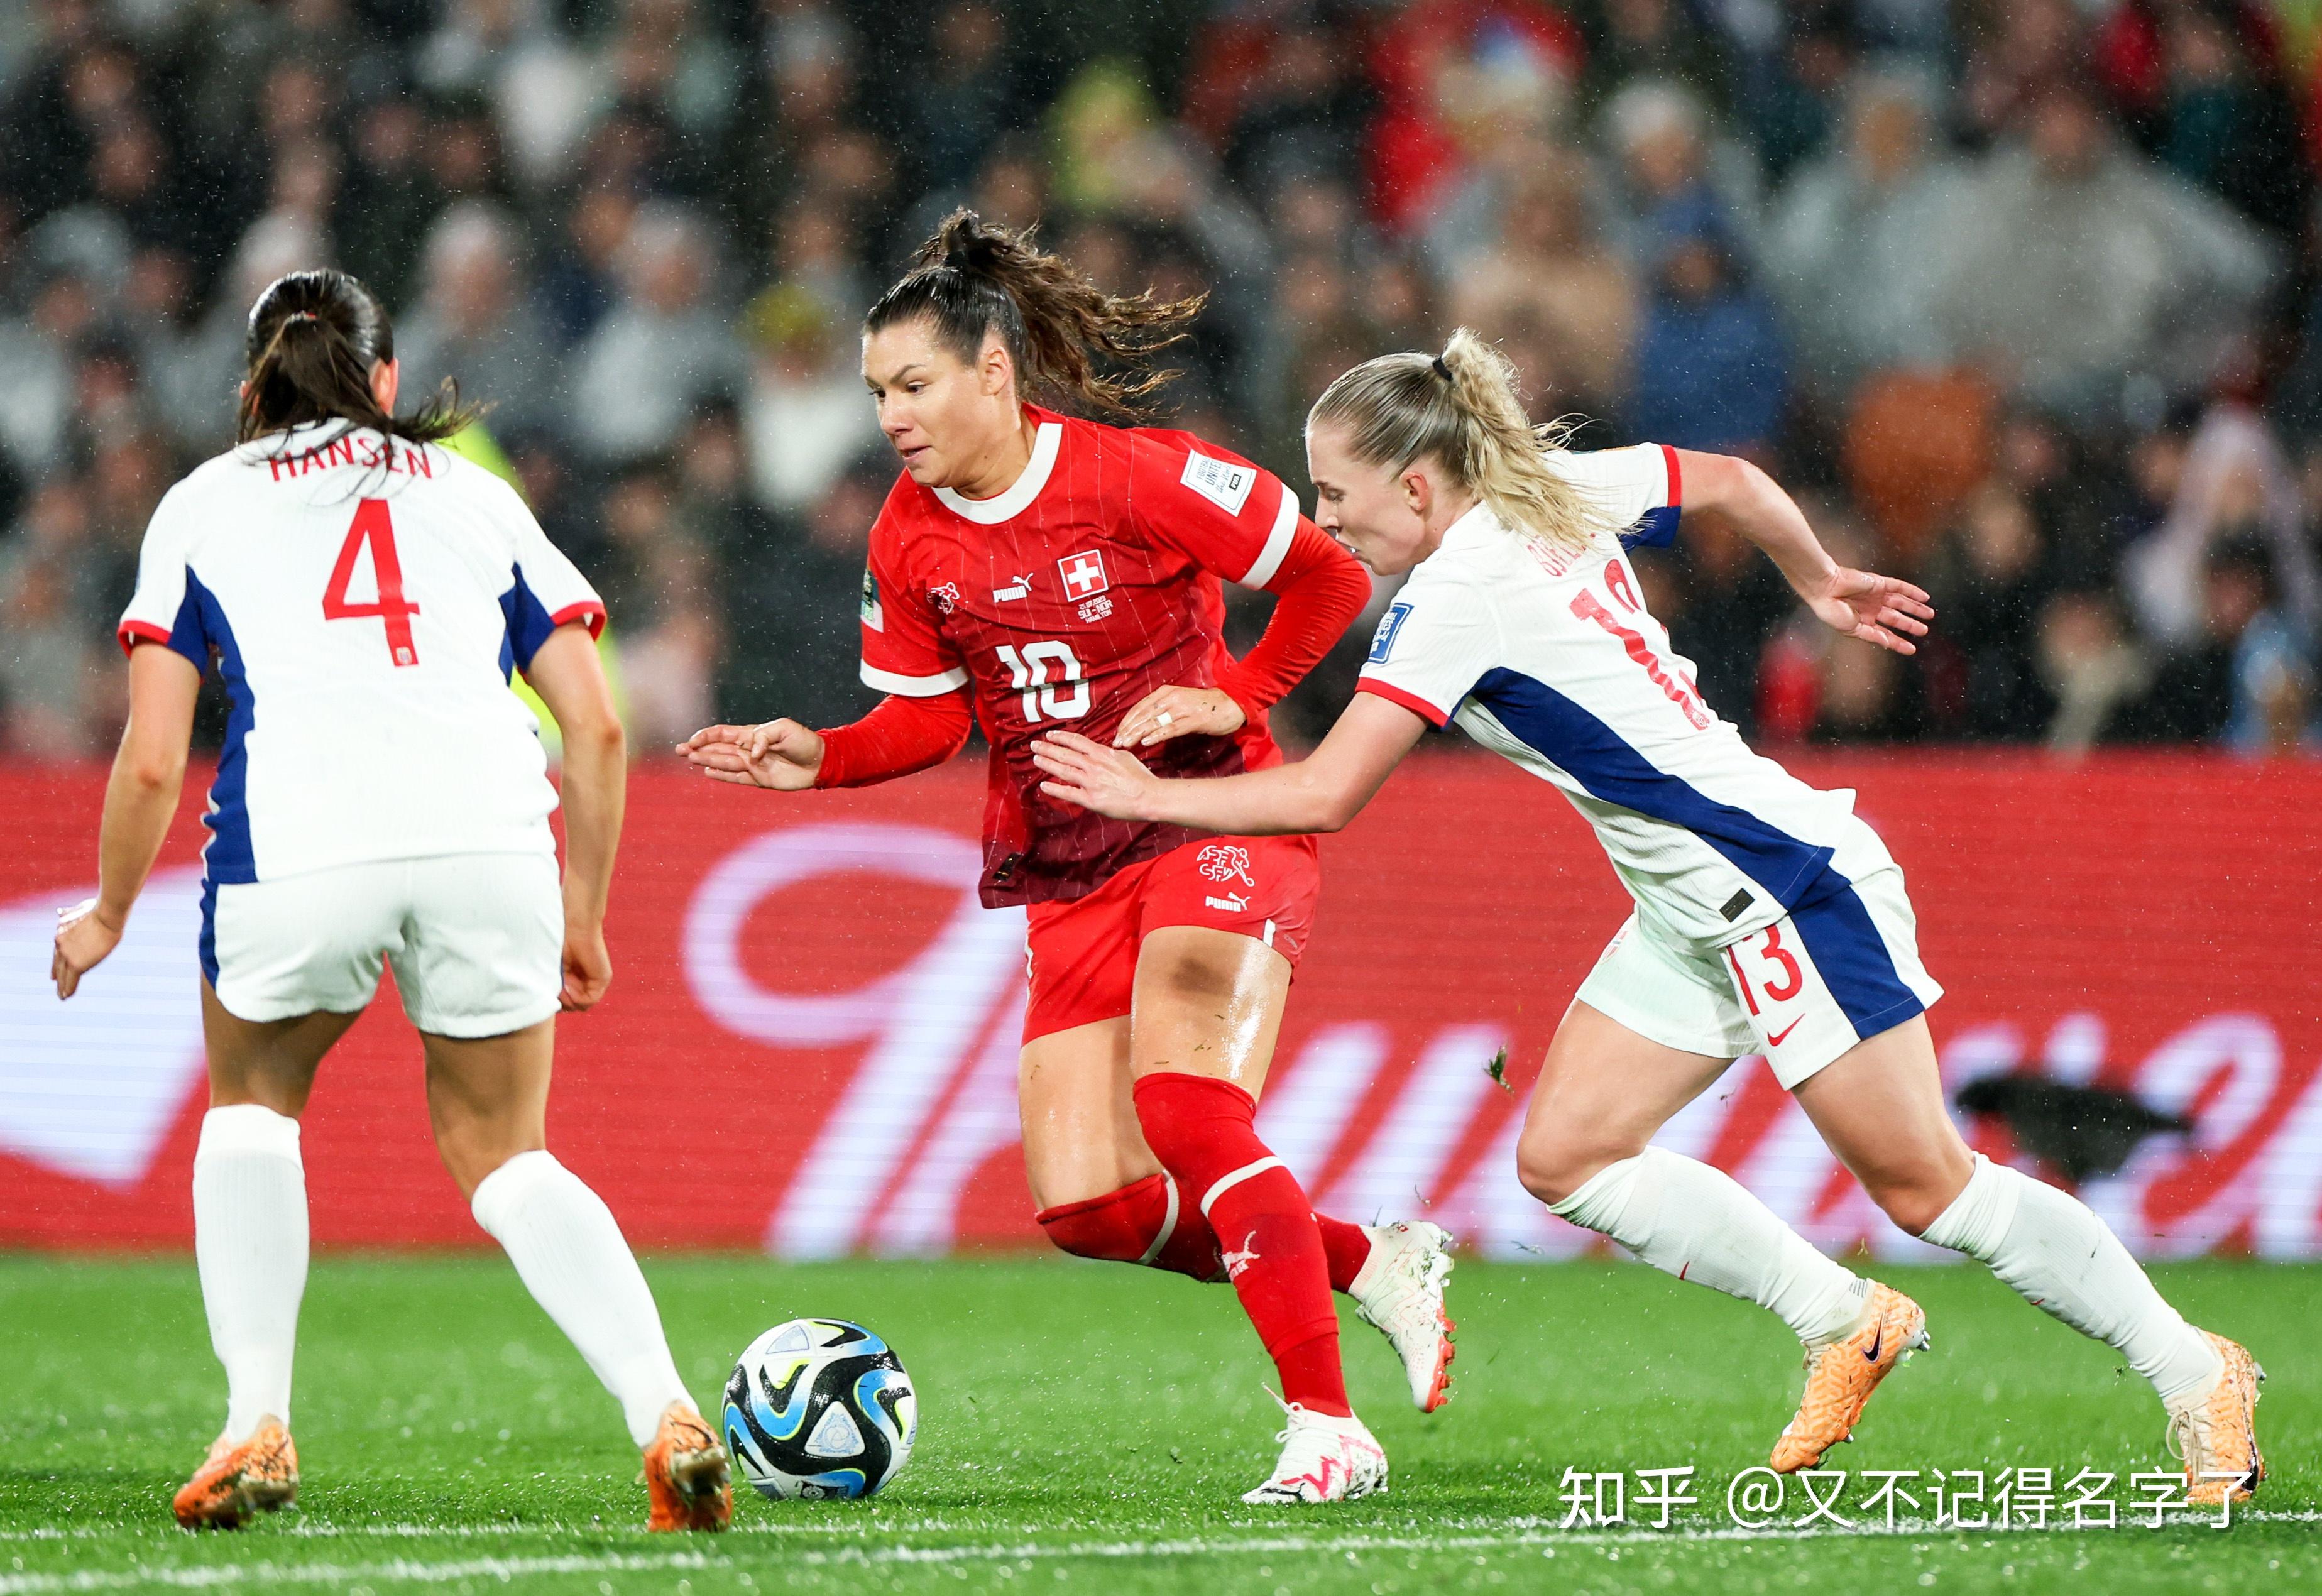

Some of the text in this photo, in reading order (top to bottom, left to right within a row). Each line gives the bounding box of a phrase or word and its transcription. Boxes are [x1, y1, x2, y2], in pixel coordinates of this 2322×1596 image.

[267, 435, 432, 482] HANSEN
[1230, 474, 1240, 489] FIFA
[321, 498, 420, 667] 4
[992, 585, 1028, 603] PUMA
[1085, 608, 1112, 624] HAMILTON
[995, 640, 1092, 723] 10
[1205, 895, 1242, 912] PUMA
[1726, 923, 1803, 1017] 13
